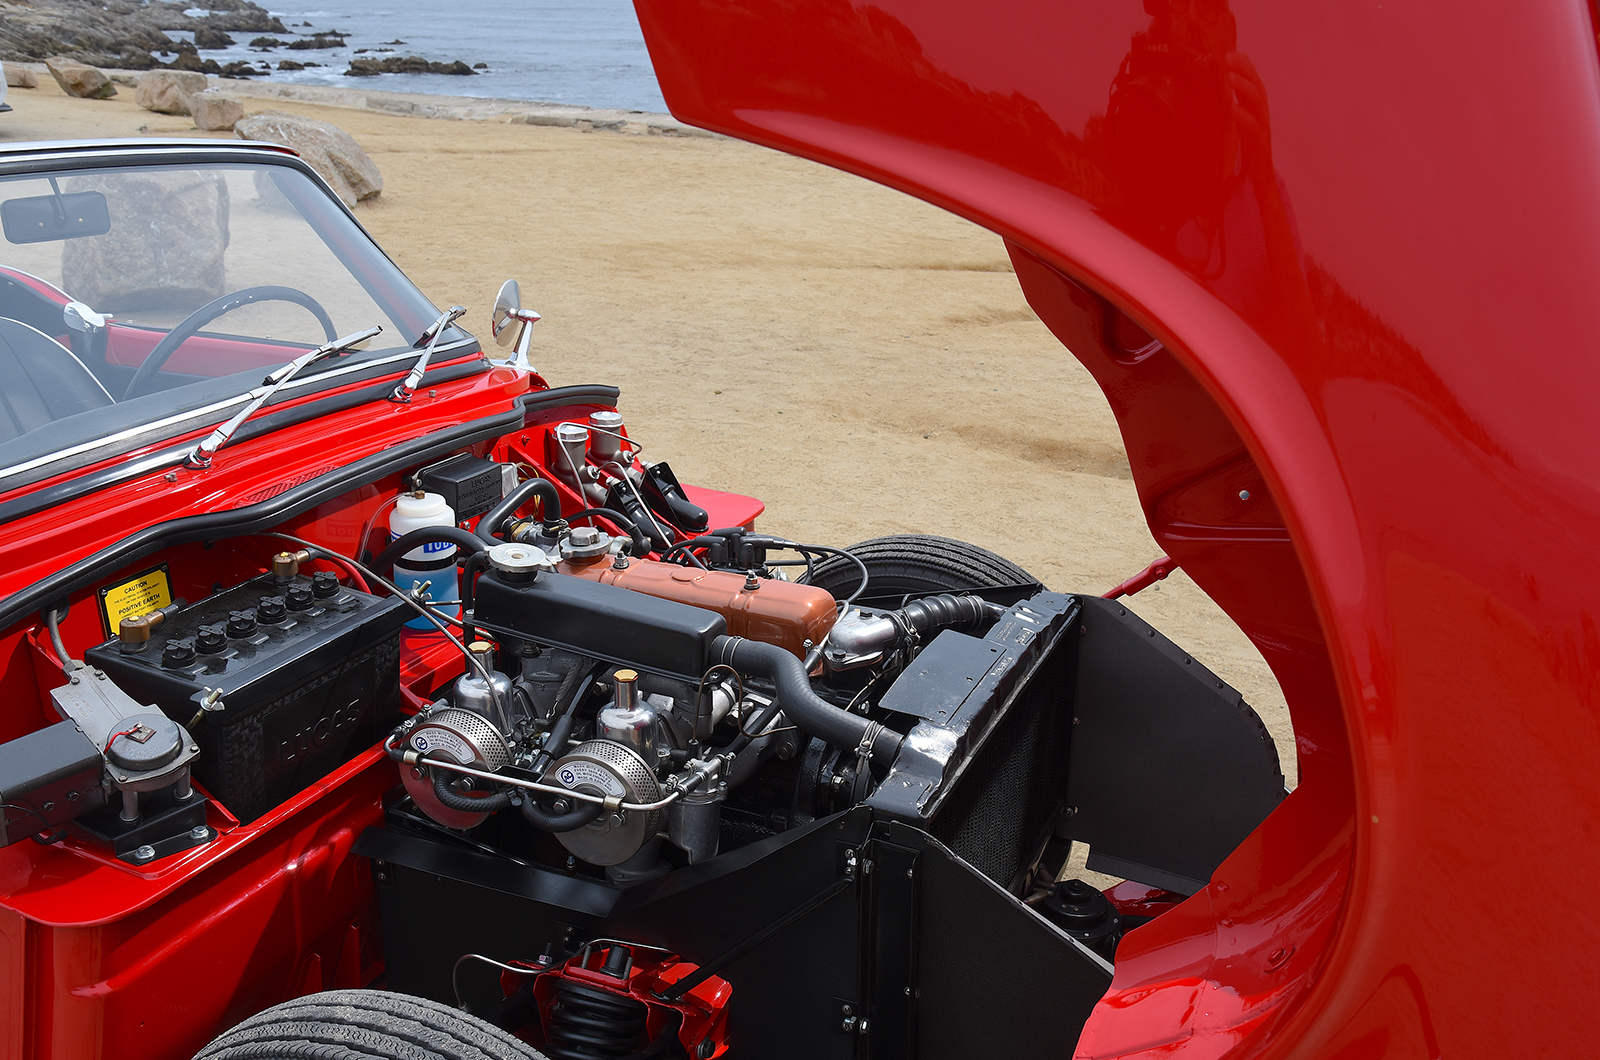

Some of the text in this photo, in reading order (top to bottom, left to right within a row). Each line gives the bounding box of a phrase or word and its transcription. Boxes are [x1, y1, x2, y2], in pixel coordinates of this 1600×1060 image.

[471, 473, 491, 487] LUCAS
[428, 541, 455, 551] TUD
[124, 581, 148, 594] CAUTION
[118, 601, 142, 615] POSITIVE
[143, 593, 160, 605] EARTH
[280, 697, 361, 769] LUCAS
